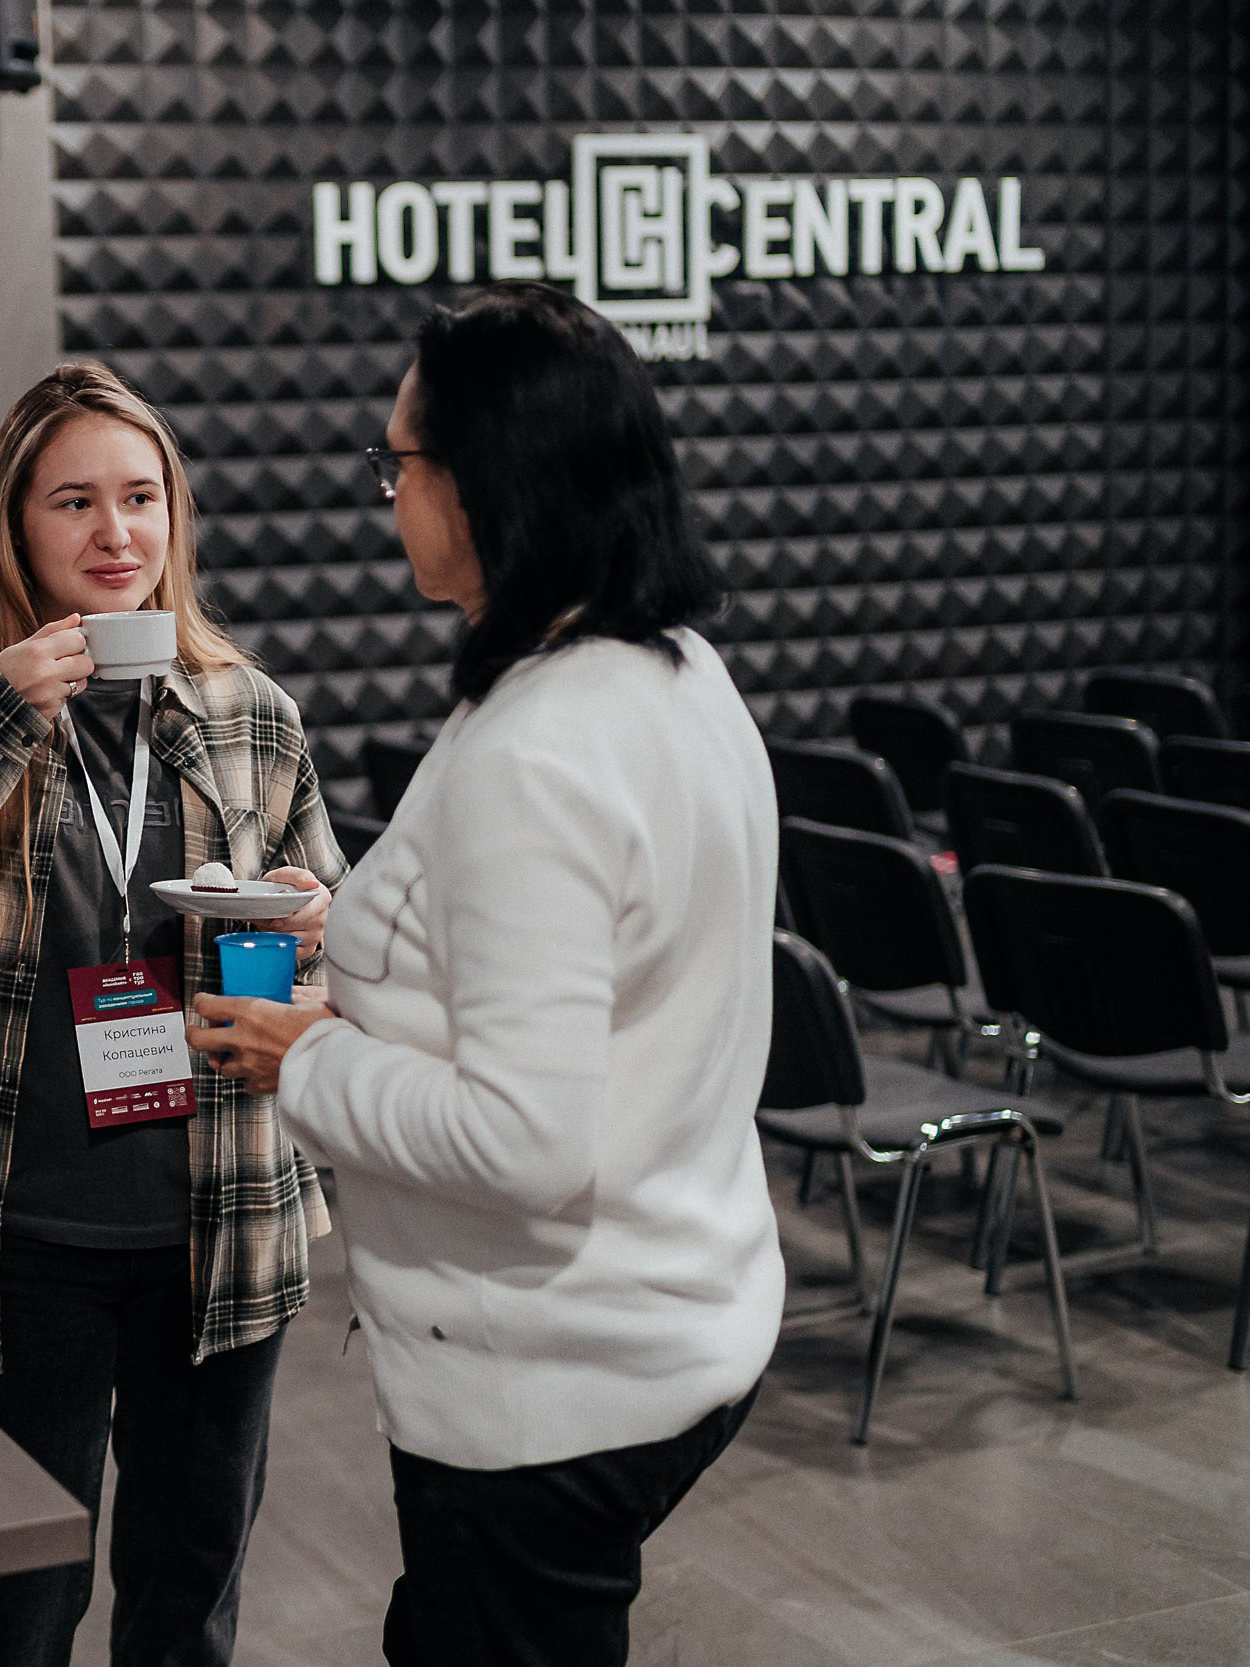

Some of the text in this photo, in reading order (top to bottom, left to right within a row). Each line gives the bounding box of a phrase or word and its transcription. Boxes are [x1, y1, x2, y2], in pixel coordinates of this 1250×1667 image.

[312, 180, 578, 286] HOTEL
[707, 176, 1046, 278] CENTRAL
[620, 322, 711, 362] NAUL
[104, 1025, 166, 1041] Кристина
[102, 1044, 174, 1061] Копацевич
[119, 1067, 163, 1078] ООО Регата
